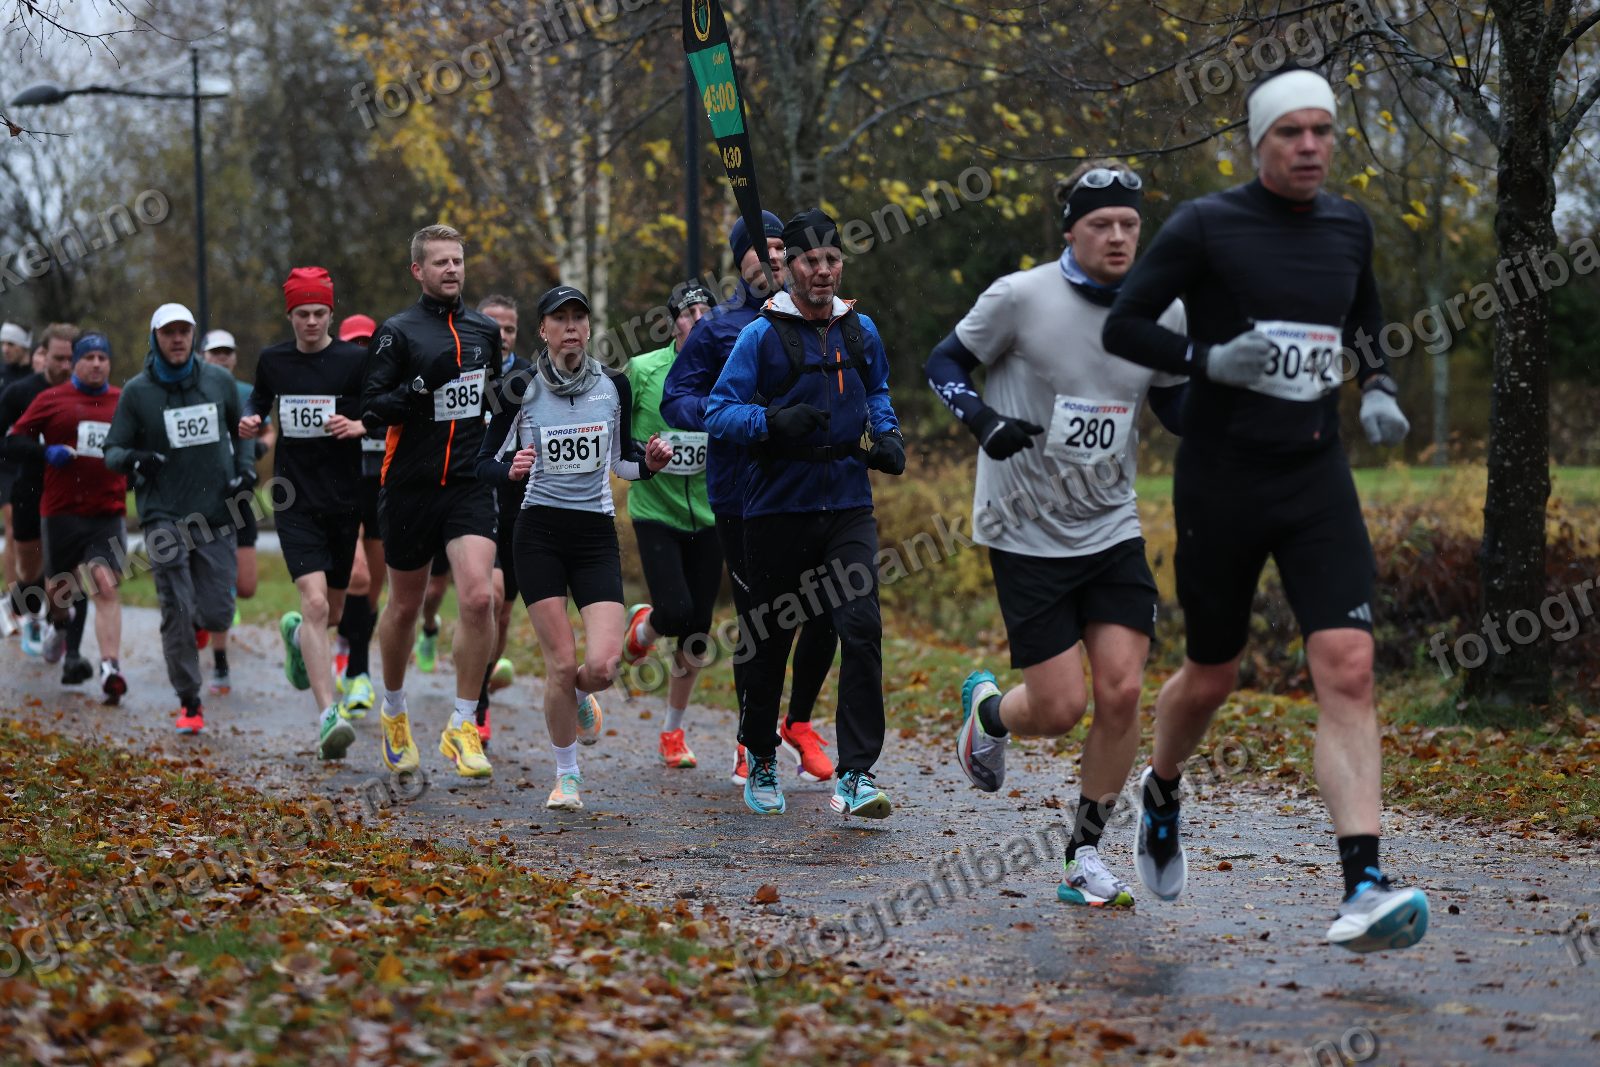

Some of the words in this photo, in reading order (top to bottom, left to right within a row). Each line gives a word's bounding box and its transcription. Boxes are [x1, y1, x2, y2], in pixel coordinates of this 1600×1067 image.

[1263, 343, 1333, 382] 3042
[445, 383, 480, 409] 385
[177, 416, 209, 438] 562
[290, 407, 323, 428] 165
[546, 425, 604, 437] NORGESTESTEN
[1065, 416, 1115, 449] 280
[547, 435, 600, 463] 9361
[671, 444, 707, 466] 536
